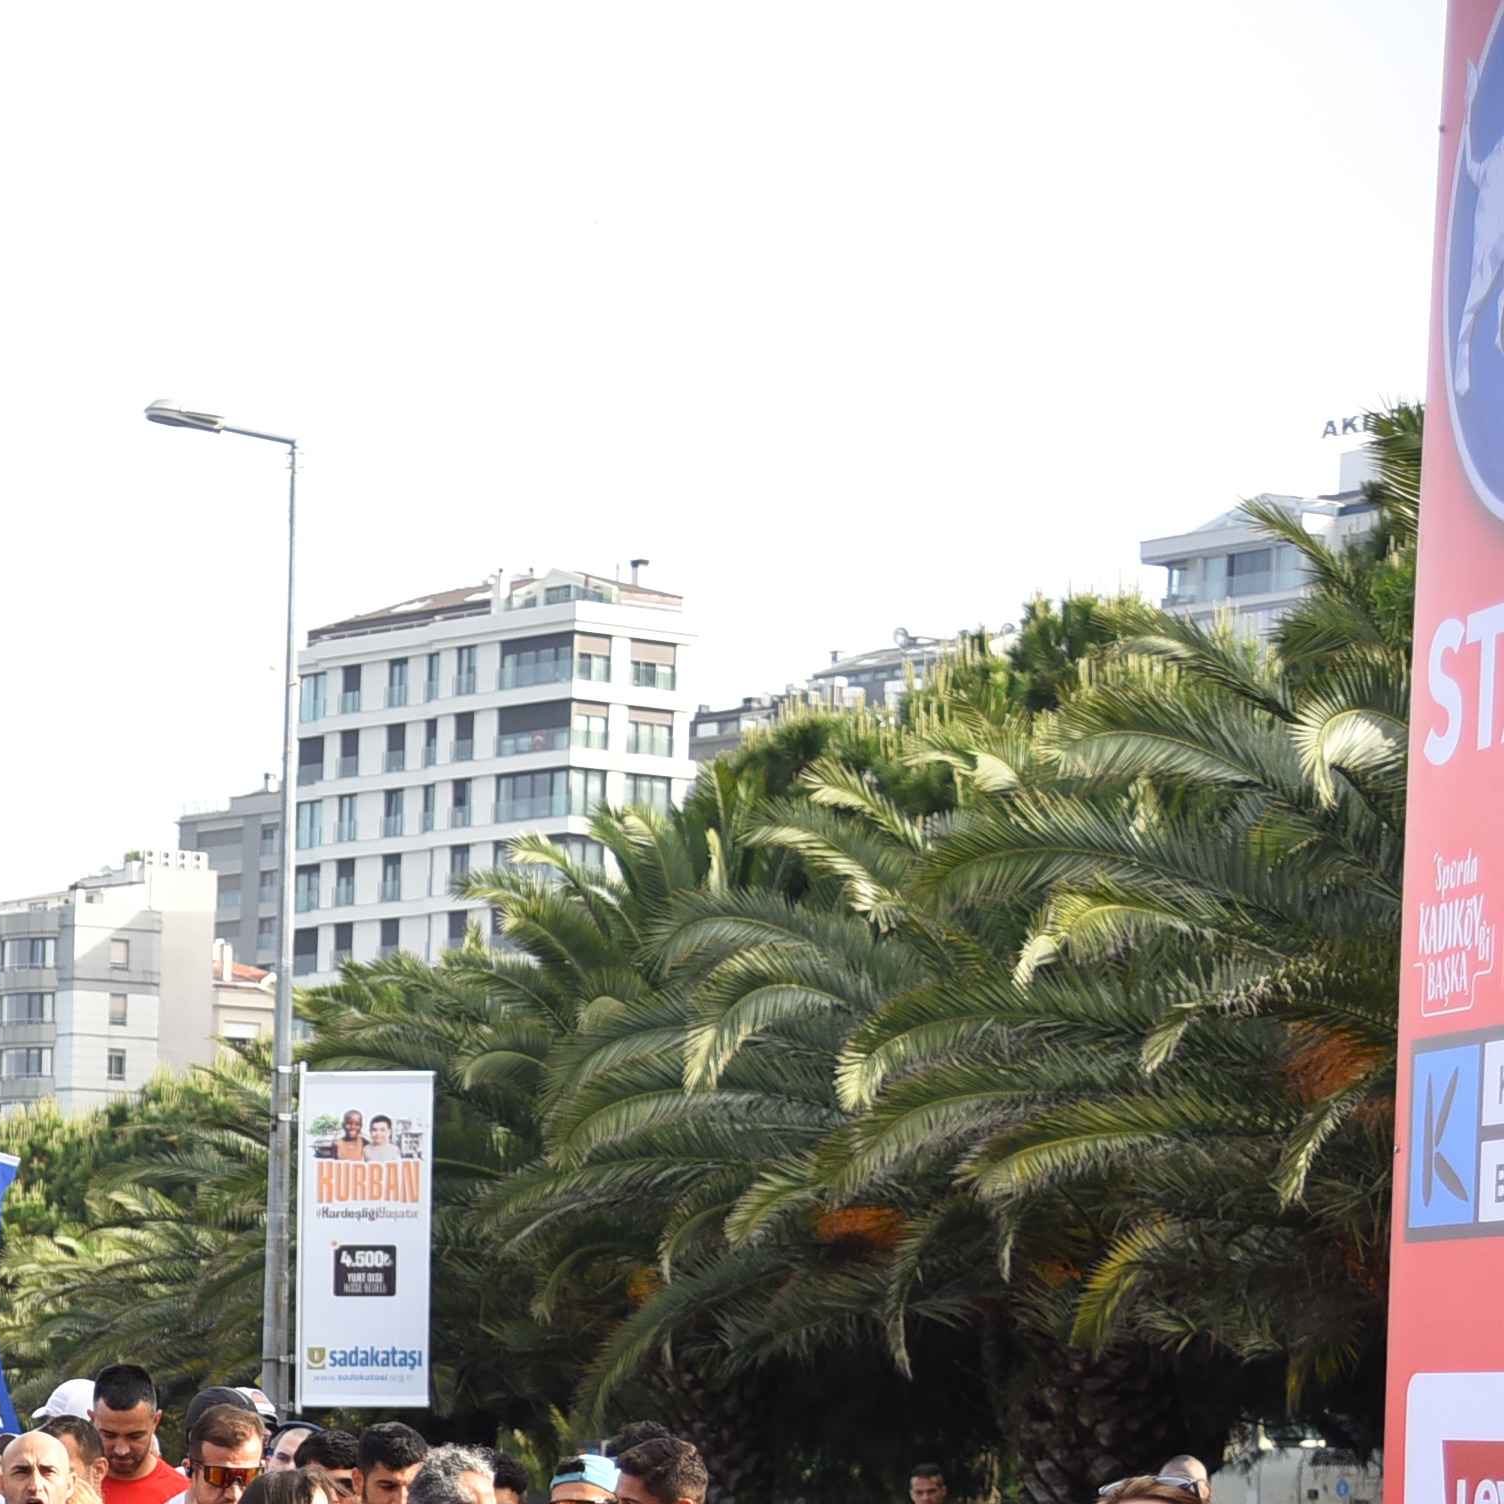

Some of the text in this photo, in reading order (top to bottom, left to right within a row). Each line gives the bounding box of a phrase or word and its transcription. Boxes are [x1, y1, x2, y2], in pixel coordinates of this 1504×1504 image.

[1423, 603, 1504, 767] ST
[1433, 849, 1479, 898] Sporda
[1418, 892, 1484, 951] KADIKÖY
[1426, 956, 1469, 1007] BAŞKA
[315, 1160, 422, 1204] KURBAN
[328, 1346, 423, 1371] sadakataşı
